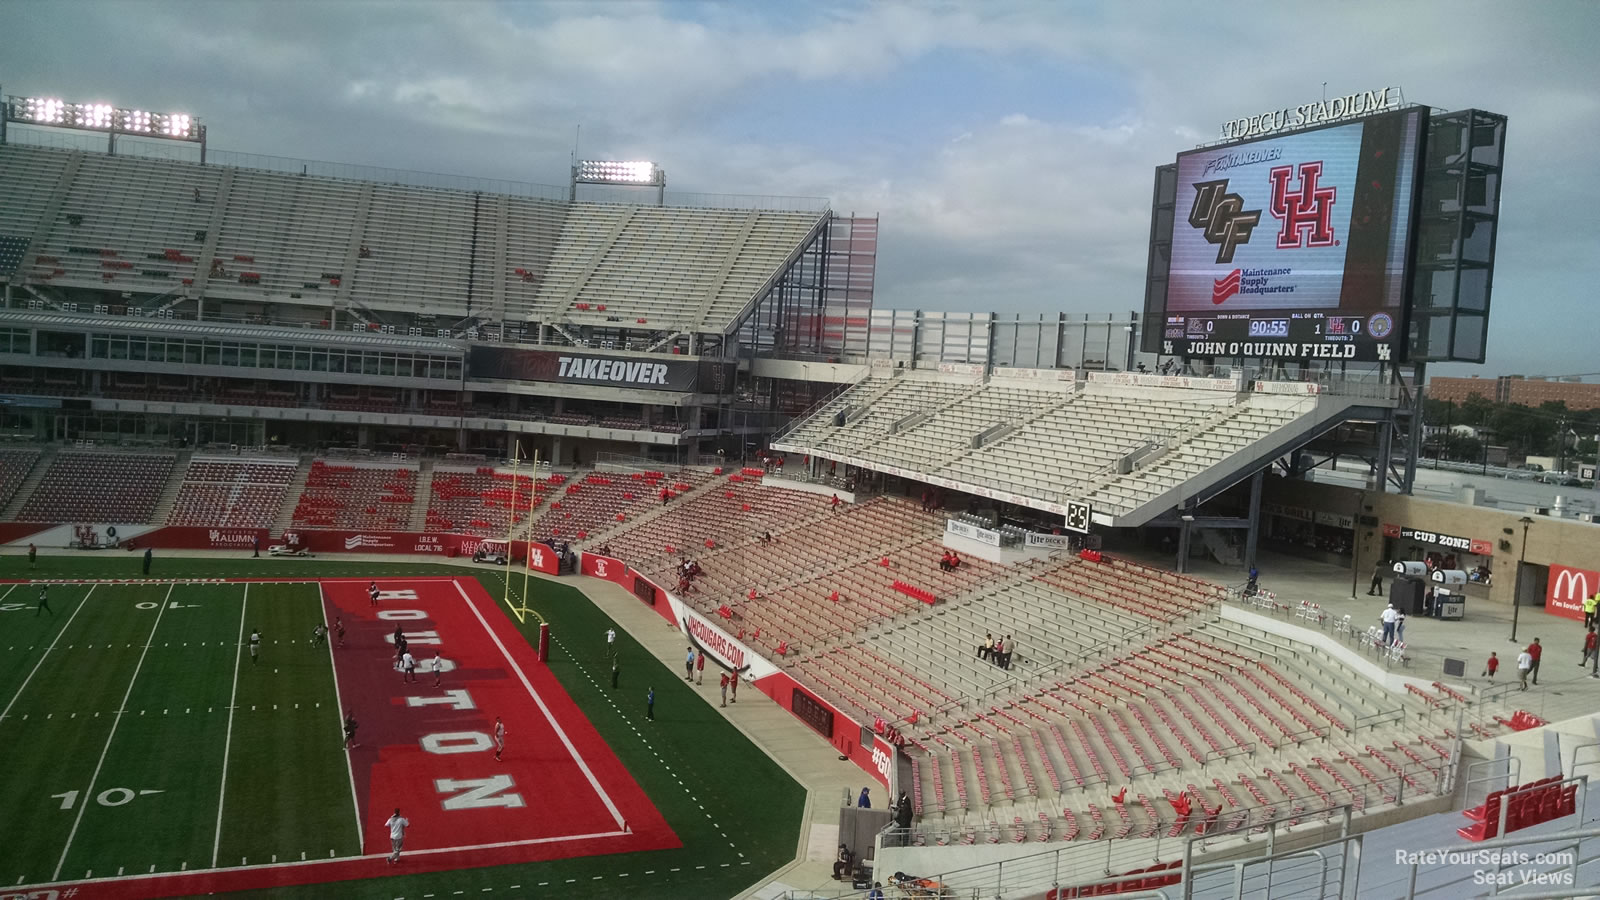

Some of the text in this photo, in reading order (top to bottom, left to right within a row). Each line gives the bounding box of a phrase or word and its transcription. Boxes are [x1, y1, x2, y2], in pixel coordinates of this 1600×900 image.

[1225, 88, 1390, 139] TDECU STADIUM
[1230, 147, 1283, 167] TAKEOVER
[1269, 160, 1337, 249] UH
[1188, 178, 1262, 264] UCF
[1241, 267, 1292, 277] Maintenance
[1241, 277, 1269, 286] Supply
[1240, 285, 1295, 295] Headquarters
[1206, 320, 1214, 332] 0
[1251, 320, 1287, 334] 90:55
[1314, 324, 1320, 335] 1
[1352, 320, 1360, 333] 0
[1187, 342, 1356, 358] JOHN O'QUINN FIELD
[558, 356, 668, 385] TAKEOVER
[1068, 504, 1087, 528] 25
[220, 534, 255, 543] ALUMN
[461, 540, 508, 551] MEMORIAL
[1030, 535, 1044, 544] Lite
[1414, 530, 1436, 544] CUB
[1439, 536, 1470, 550] ZONE
[531, 548, 544, 568] UH
[1552, 599, 1563, 608] i'm
[1563, 602, 1582, 612] lovin'
[687, 614, 744, 669] UHCOUGARS.COM
[374, 590, 527, 812] HOUSTON
[51, 788, 136, 810] 10
